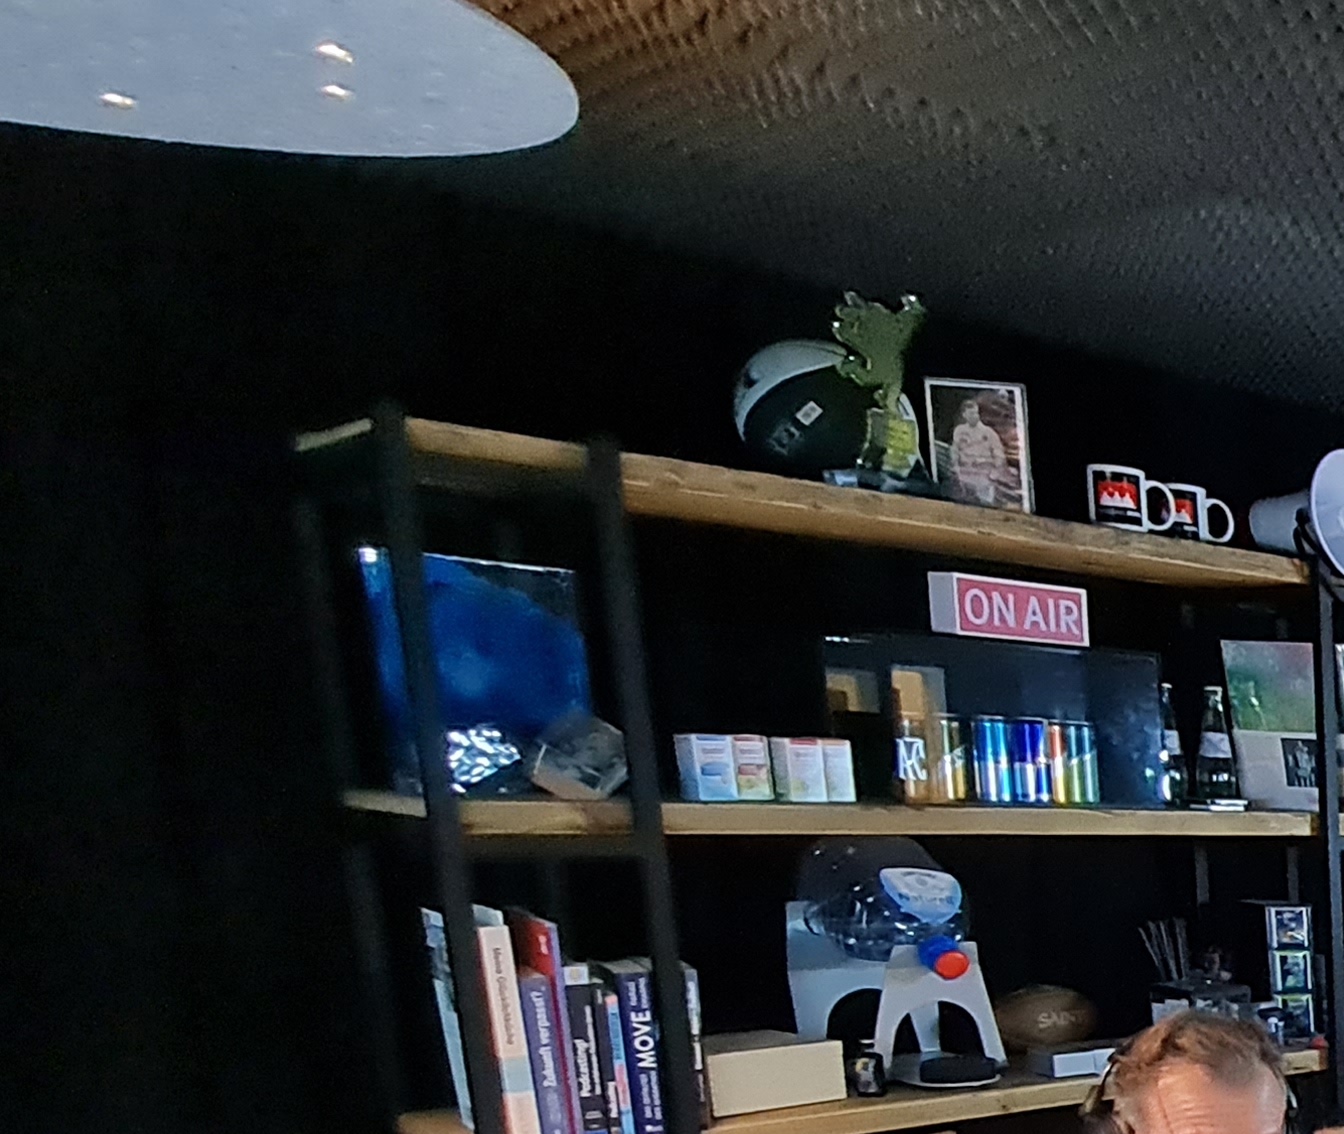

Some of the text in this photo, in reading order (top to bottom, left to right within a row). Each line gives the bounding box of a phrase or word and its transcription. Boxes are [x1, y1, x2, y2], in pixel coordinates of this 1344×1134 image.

[964, 587, 1080, 635] ON AIR
[630, 1010, 658, 1068] MOVE
[537, 1046, 557, 1087] Zukunft
